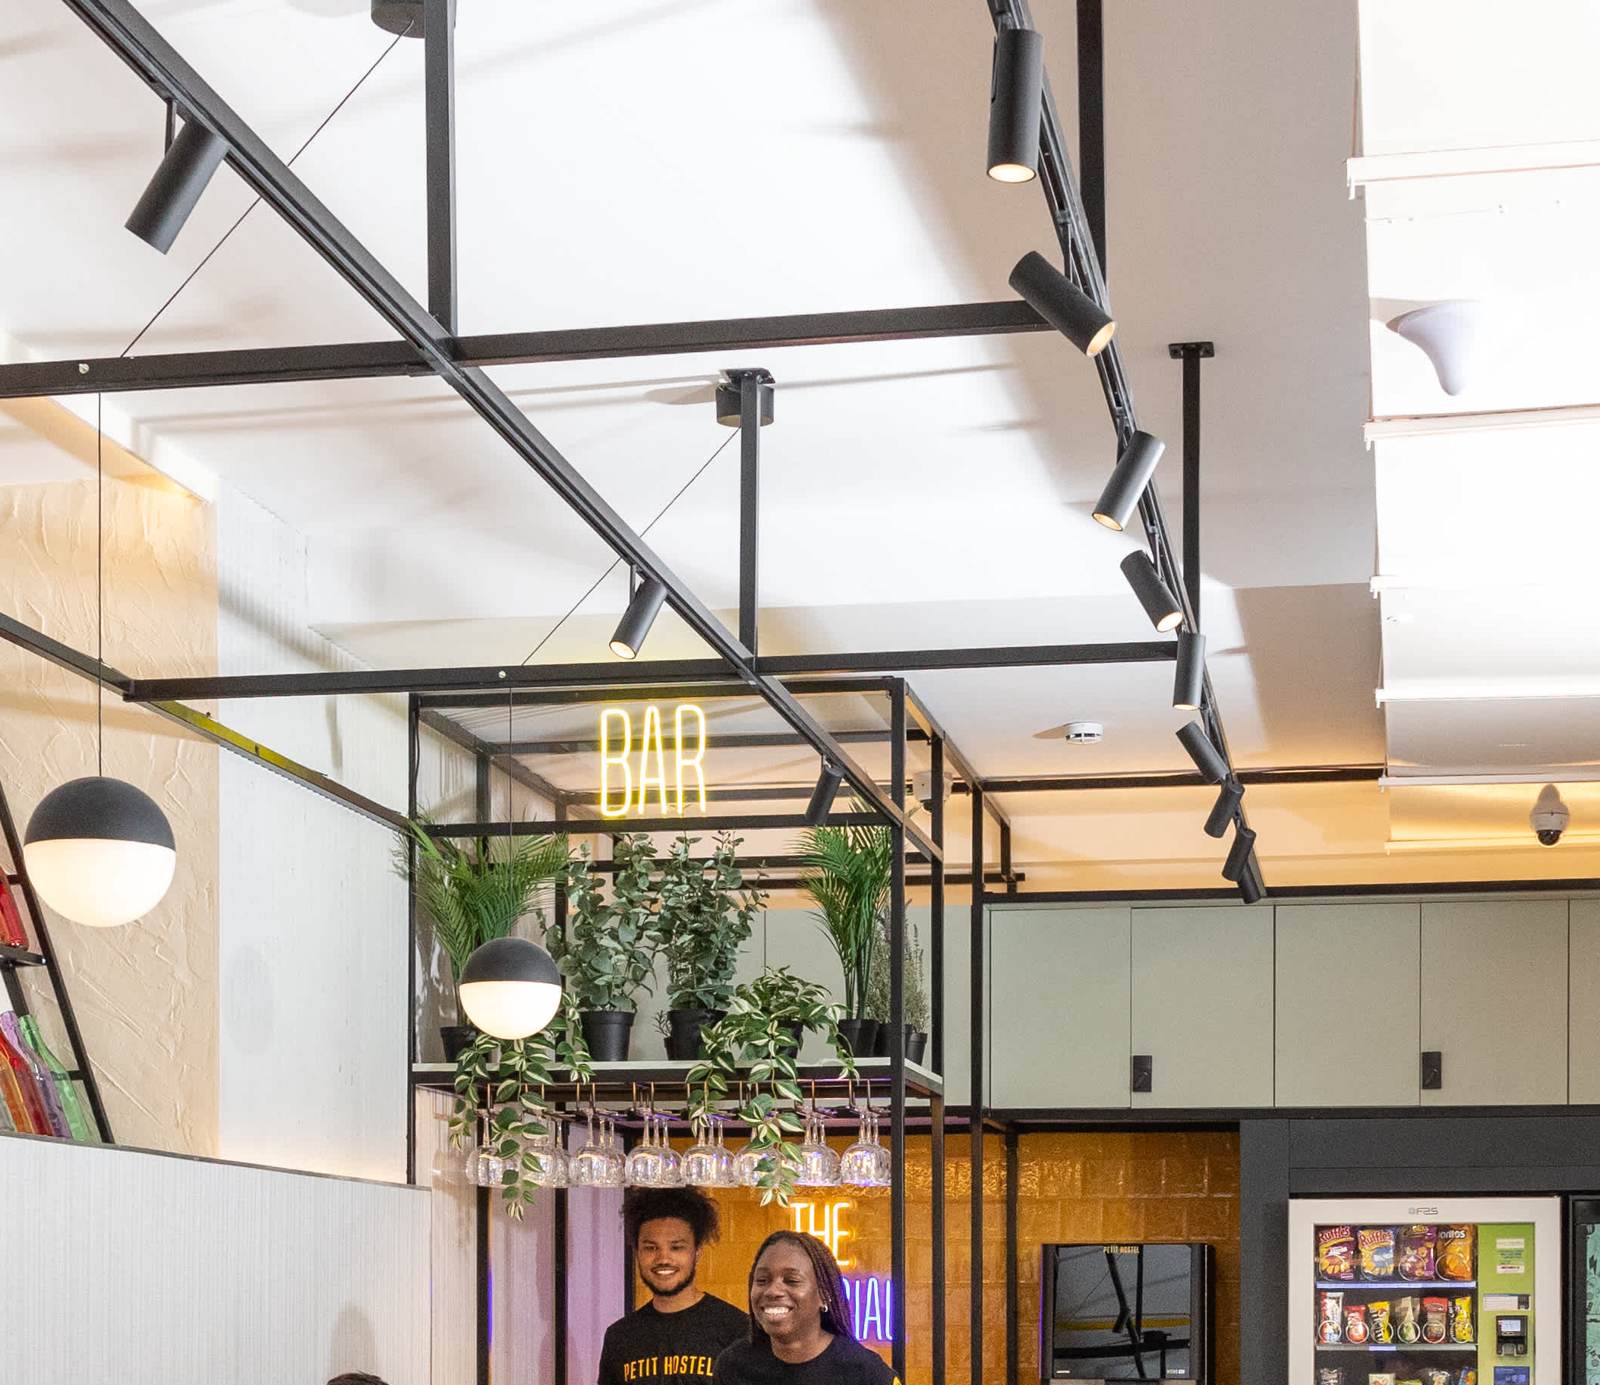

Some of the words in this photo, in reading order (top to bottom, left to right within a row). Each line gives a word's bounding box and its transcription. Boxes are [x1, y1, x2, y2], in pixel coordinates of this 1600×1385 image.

[600, 703, 706, 817] BAR
[788, 1201, 851, 1267] THE
[1318, 1225, 1351, 1244] Ruffles
[1359, 1230, 1394, 1248] Ruffles
[623, 1357, 658, 1382] PETIT
[664, 1355, 714, 1377] HOSTEL
